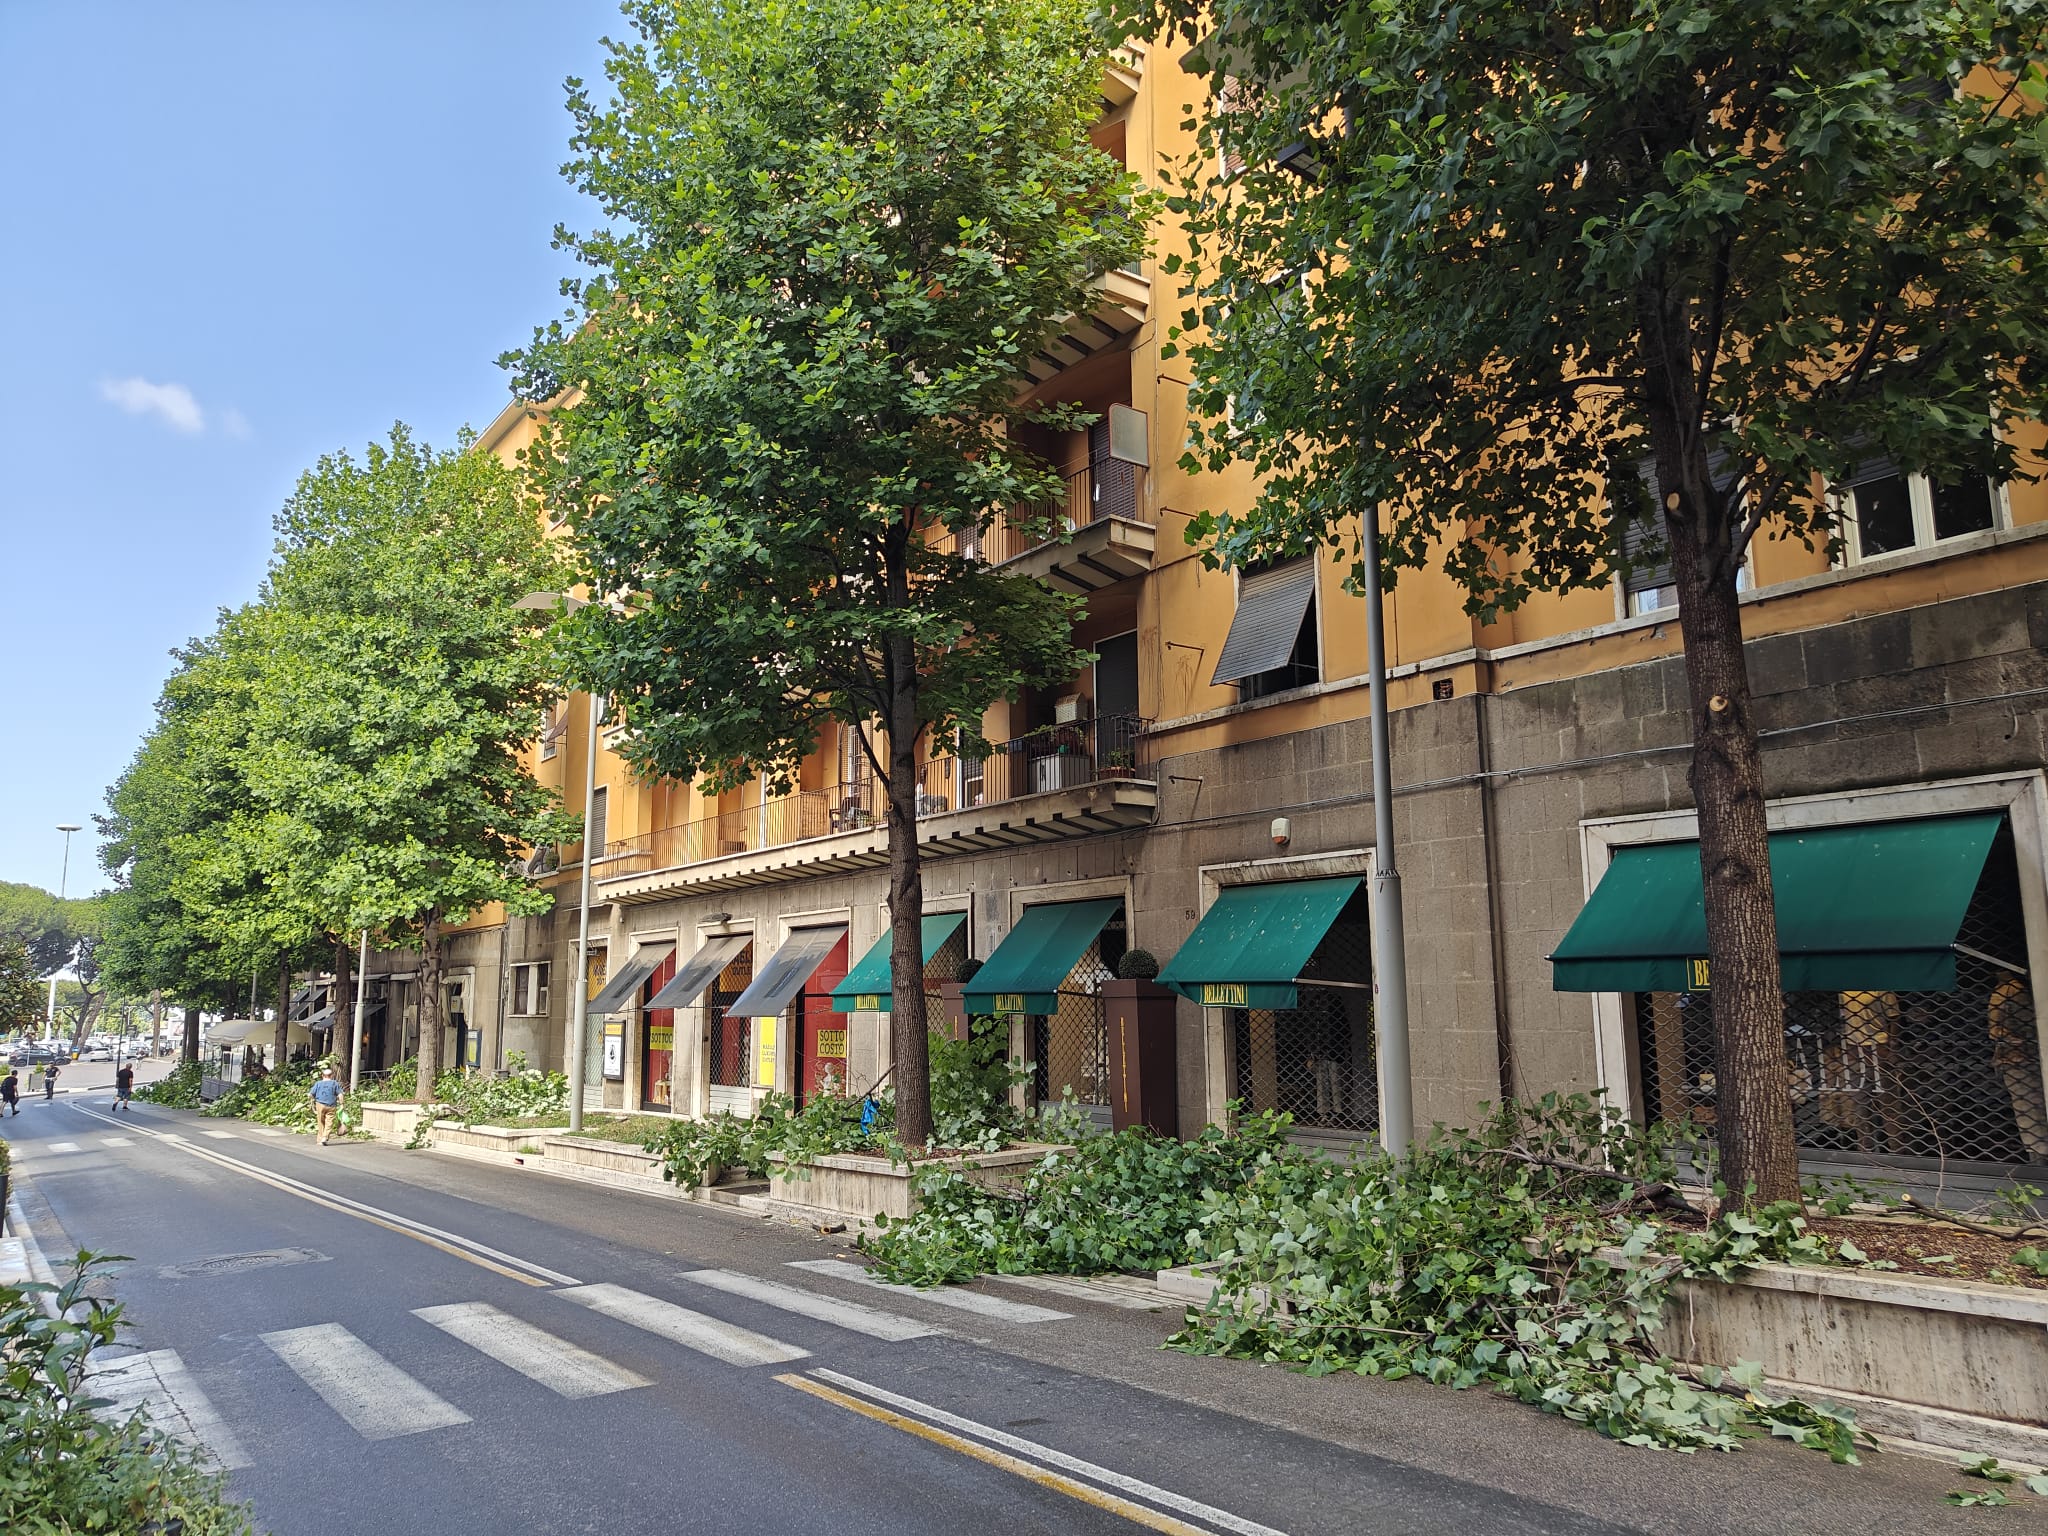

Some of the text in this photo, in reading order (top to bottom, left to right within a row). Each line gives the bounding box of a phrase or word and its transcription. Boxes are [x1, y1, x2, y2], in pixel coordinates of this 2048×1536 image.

[1185, 910, 1196, 920] 59
[1203, 984, 1245, 1003] BELLETTINI
[819, 1031, 845, 1041] SOTTO
[819, 1043, 845, 1054] COSTO
[1787, 1033, 1886, 1092] ALDI
